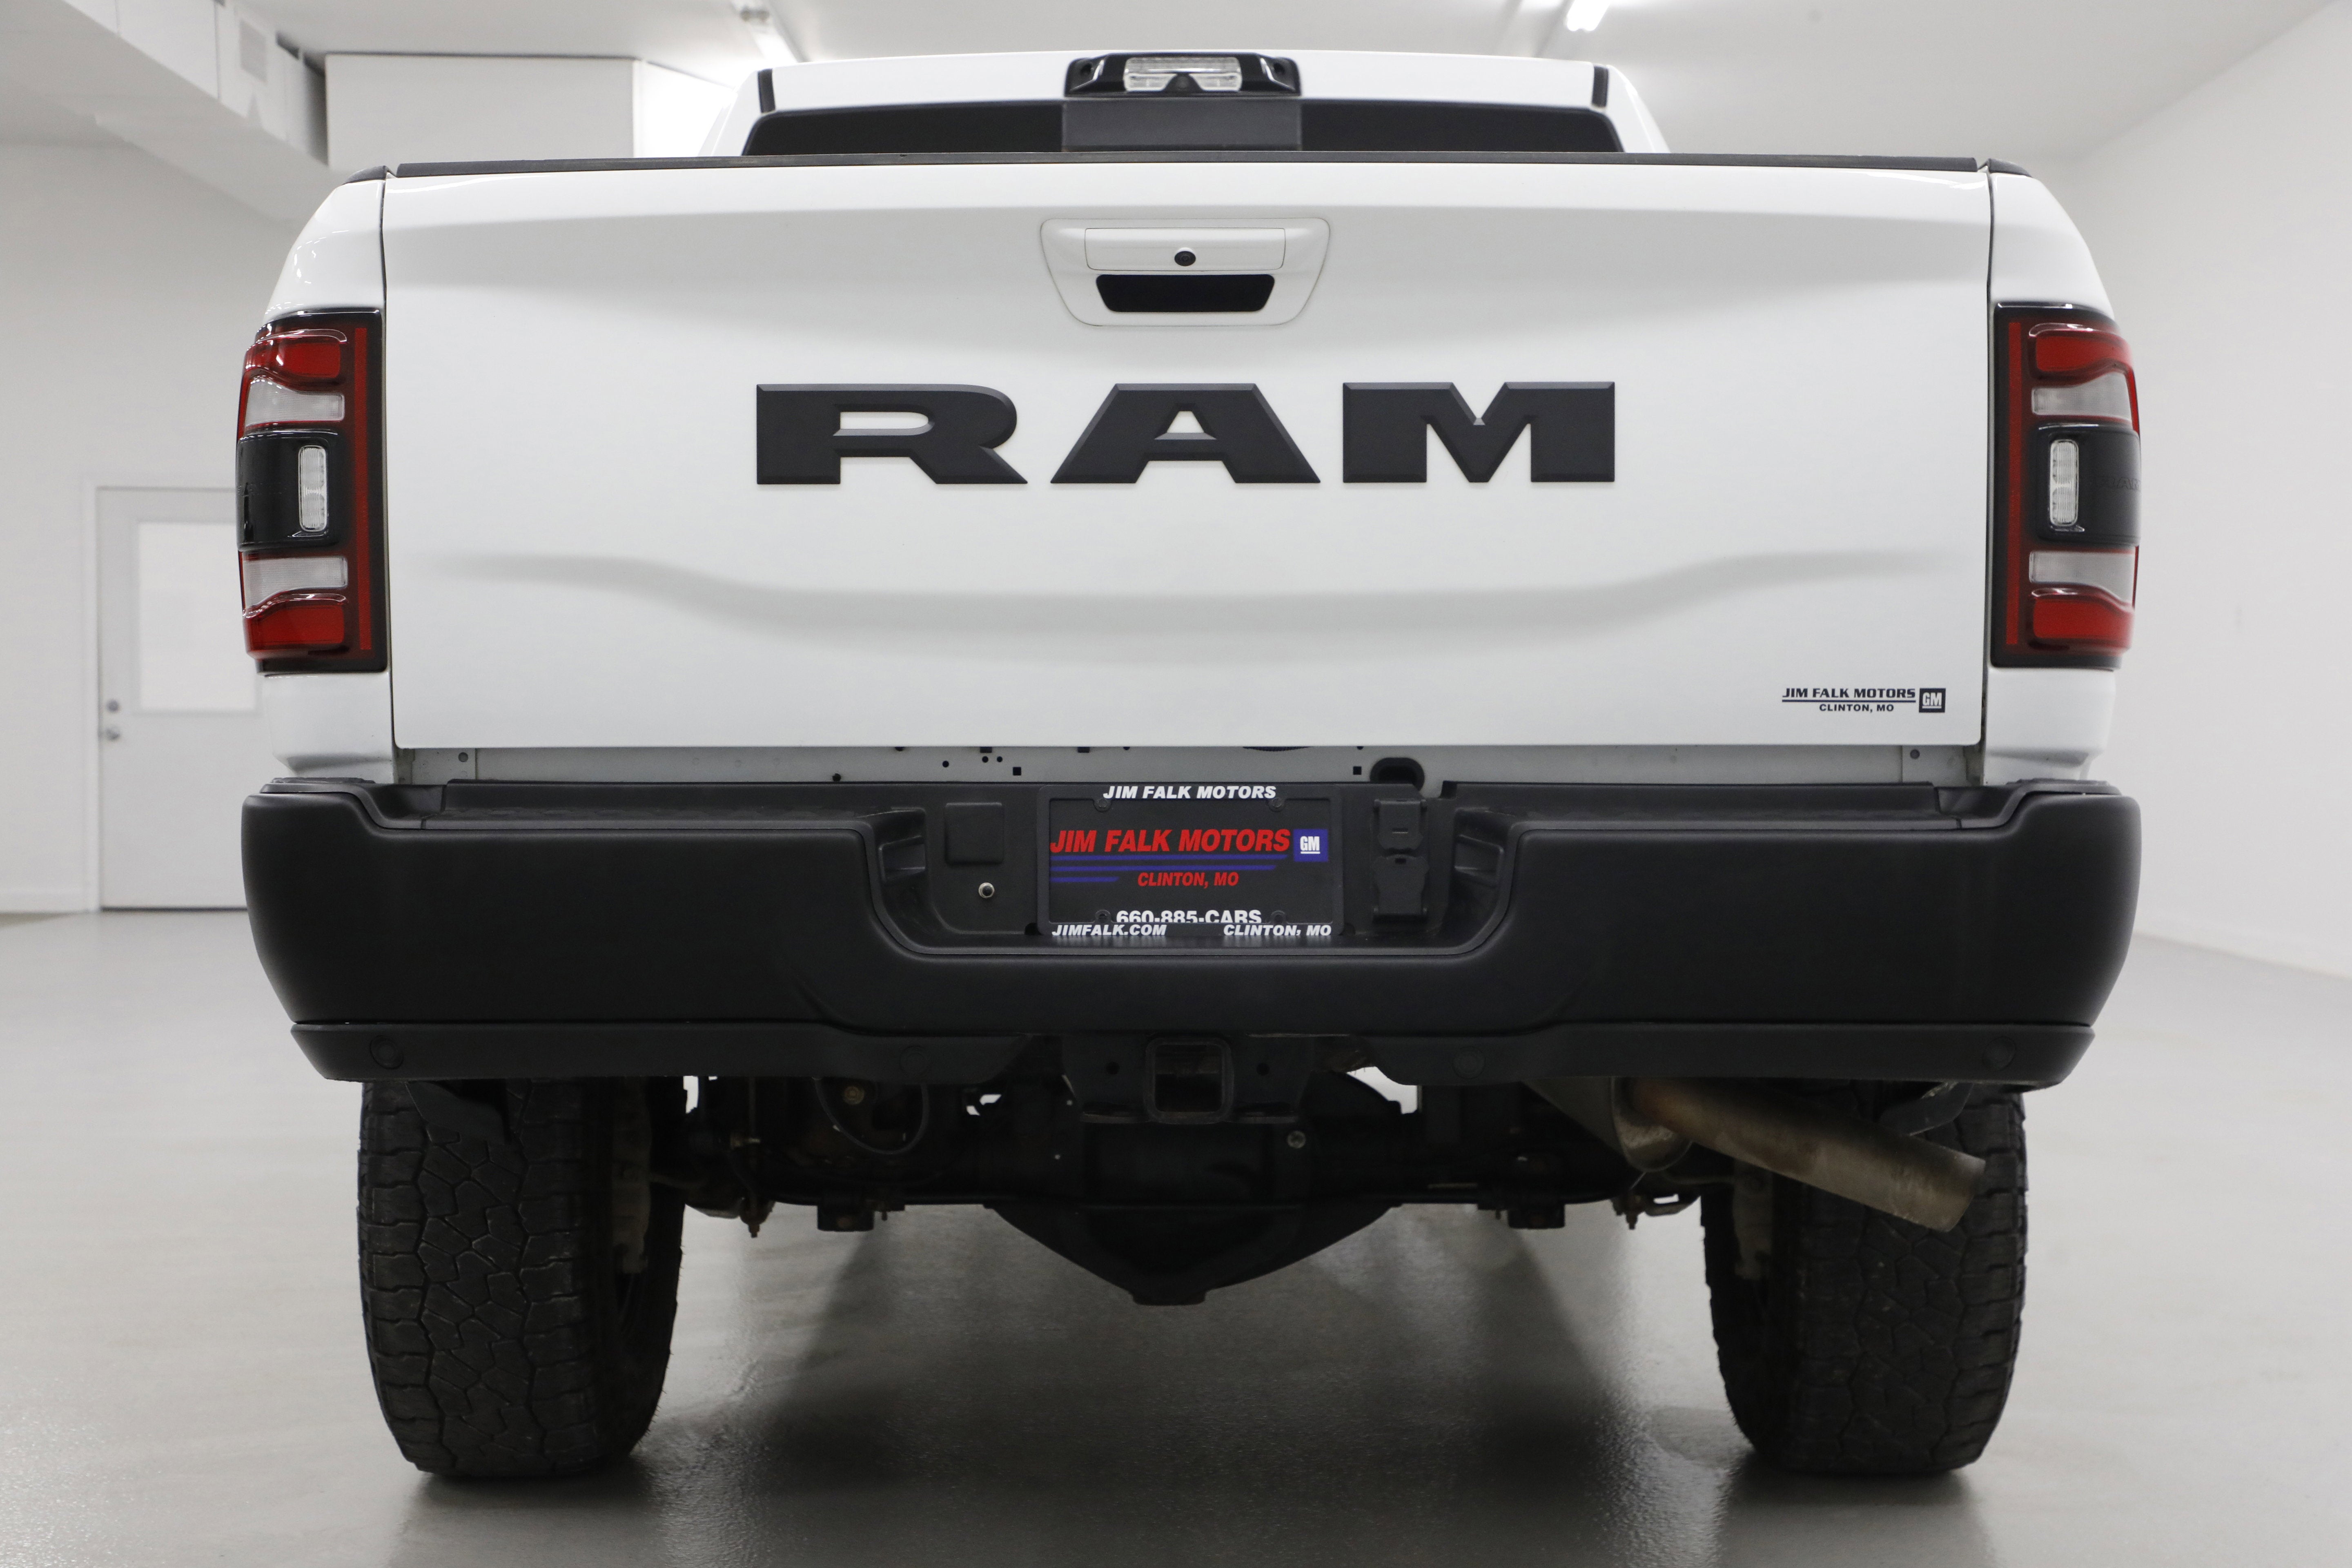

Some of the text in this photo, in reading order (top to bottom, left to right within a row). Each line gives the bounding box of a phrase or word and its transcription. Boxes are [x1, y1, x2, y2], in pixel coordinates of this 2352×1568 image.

[756, 382, 1615, 485] RAM
[1782, 688, 1916, 698] JIM FALK MOTORS
[1922, 692, 1942, 706] GM
[1819, 704, 1873, 713] CLINTON,
[1103, 786, 1276, 799] JIM FALK MOTORS
[1049, 829, 1291, 853] JIM FALK MOTORS
[1300, 835, 1321, 851] GM
[1137, 872, 1239, 889] CLINTON, MO
[1116, 910, 1262, 923] 660-885-CARS
[1051, 924, 1167, 935] JIMFALK.COM
[1223, 924, 1332, 936] CLINTON, MO
